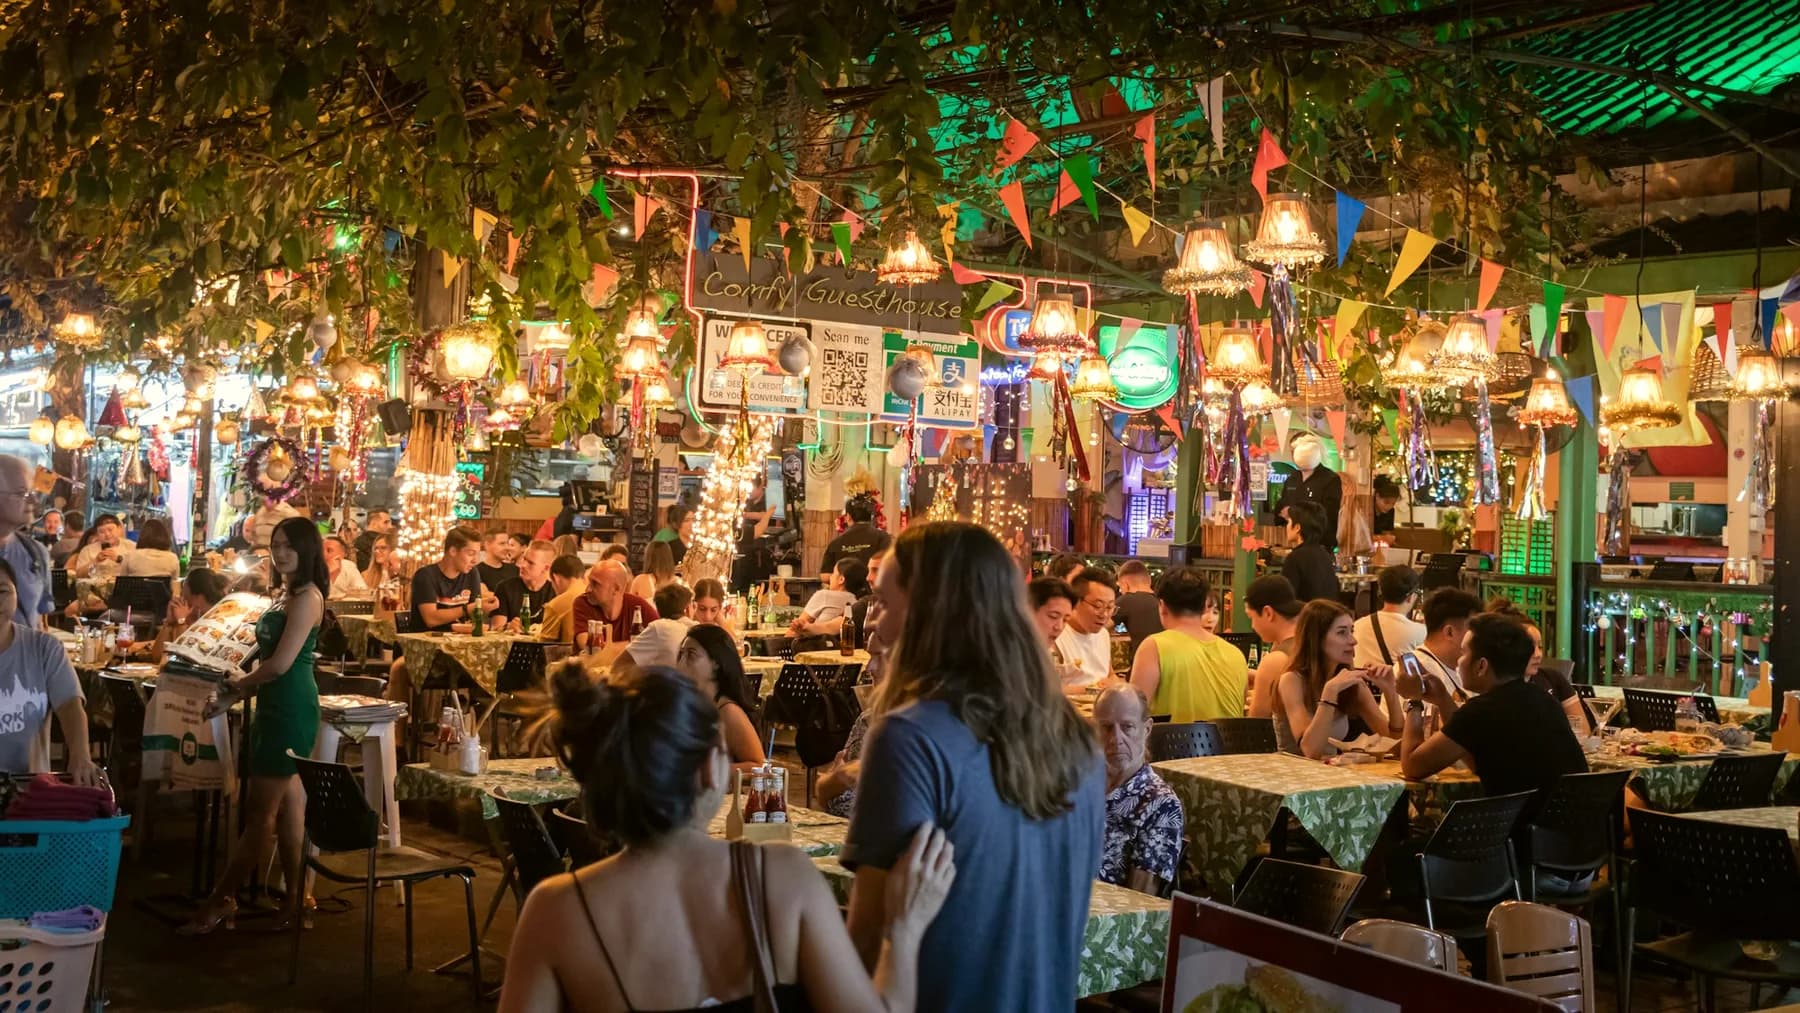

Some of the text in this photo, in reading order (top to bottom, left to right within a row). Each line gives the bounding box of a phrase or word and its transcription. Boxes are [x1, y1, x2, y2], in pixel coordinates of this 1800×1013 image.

[704, 271, 962, 318] Comfy Guesthouse
[824, 328, 870, 345] Scan me
[709, 391, 724, 399] FOR
[750, 393, 798, 403] CONVENIENCE
[934, 408, 972, 417] ALIPAY
